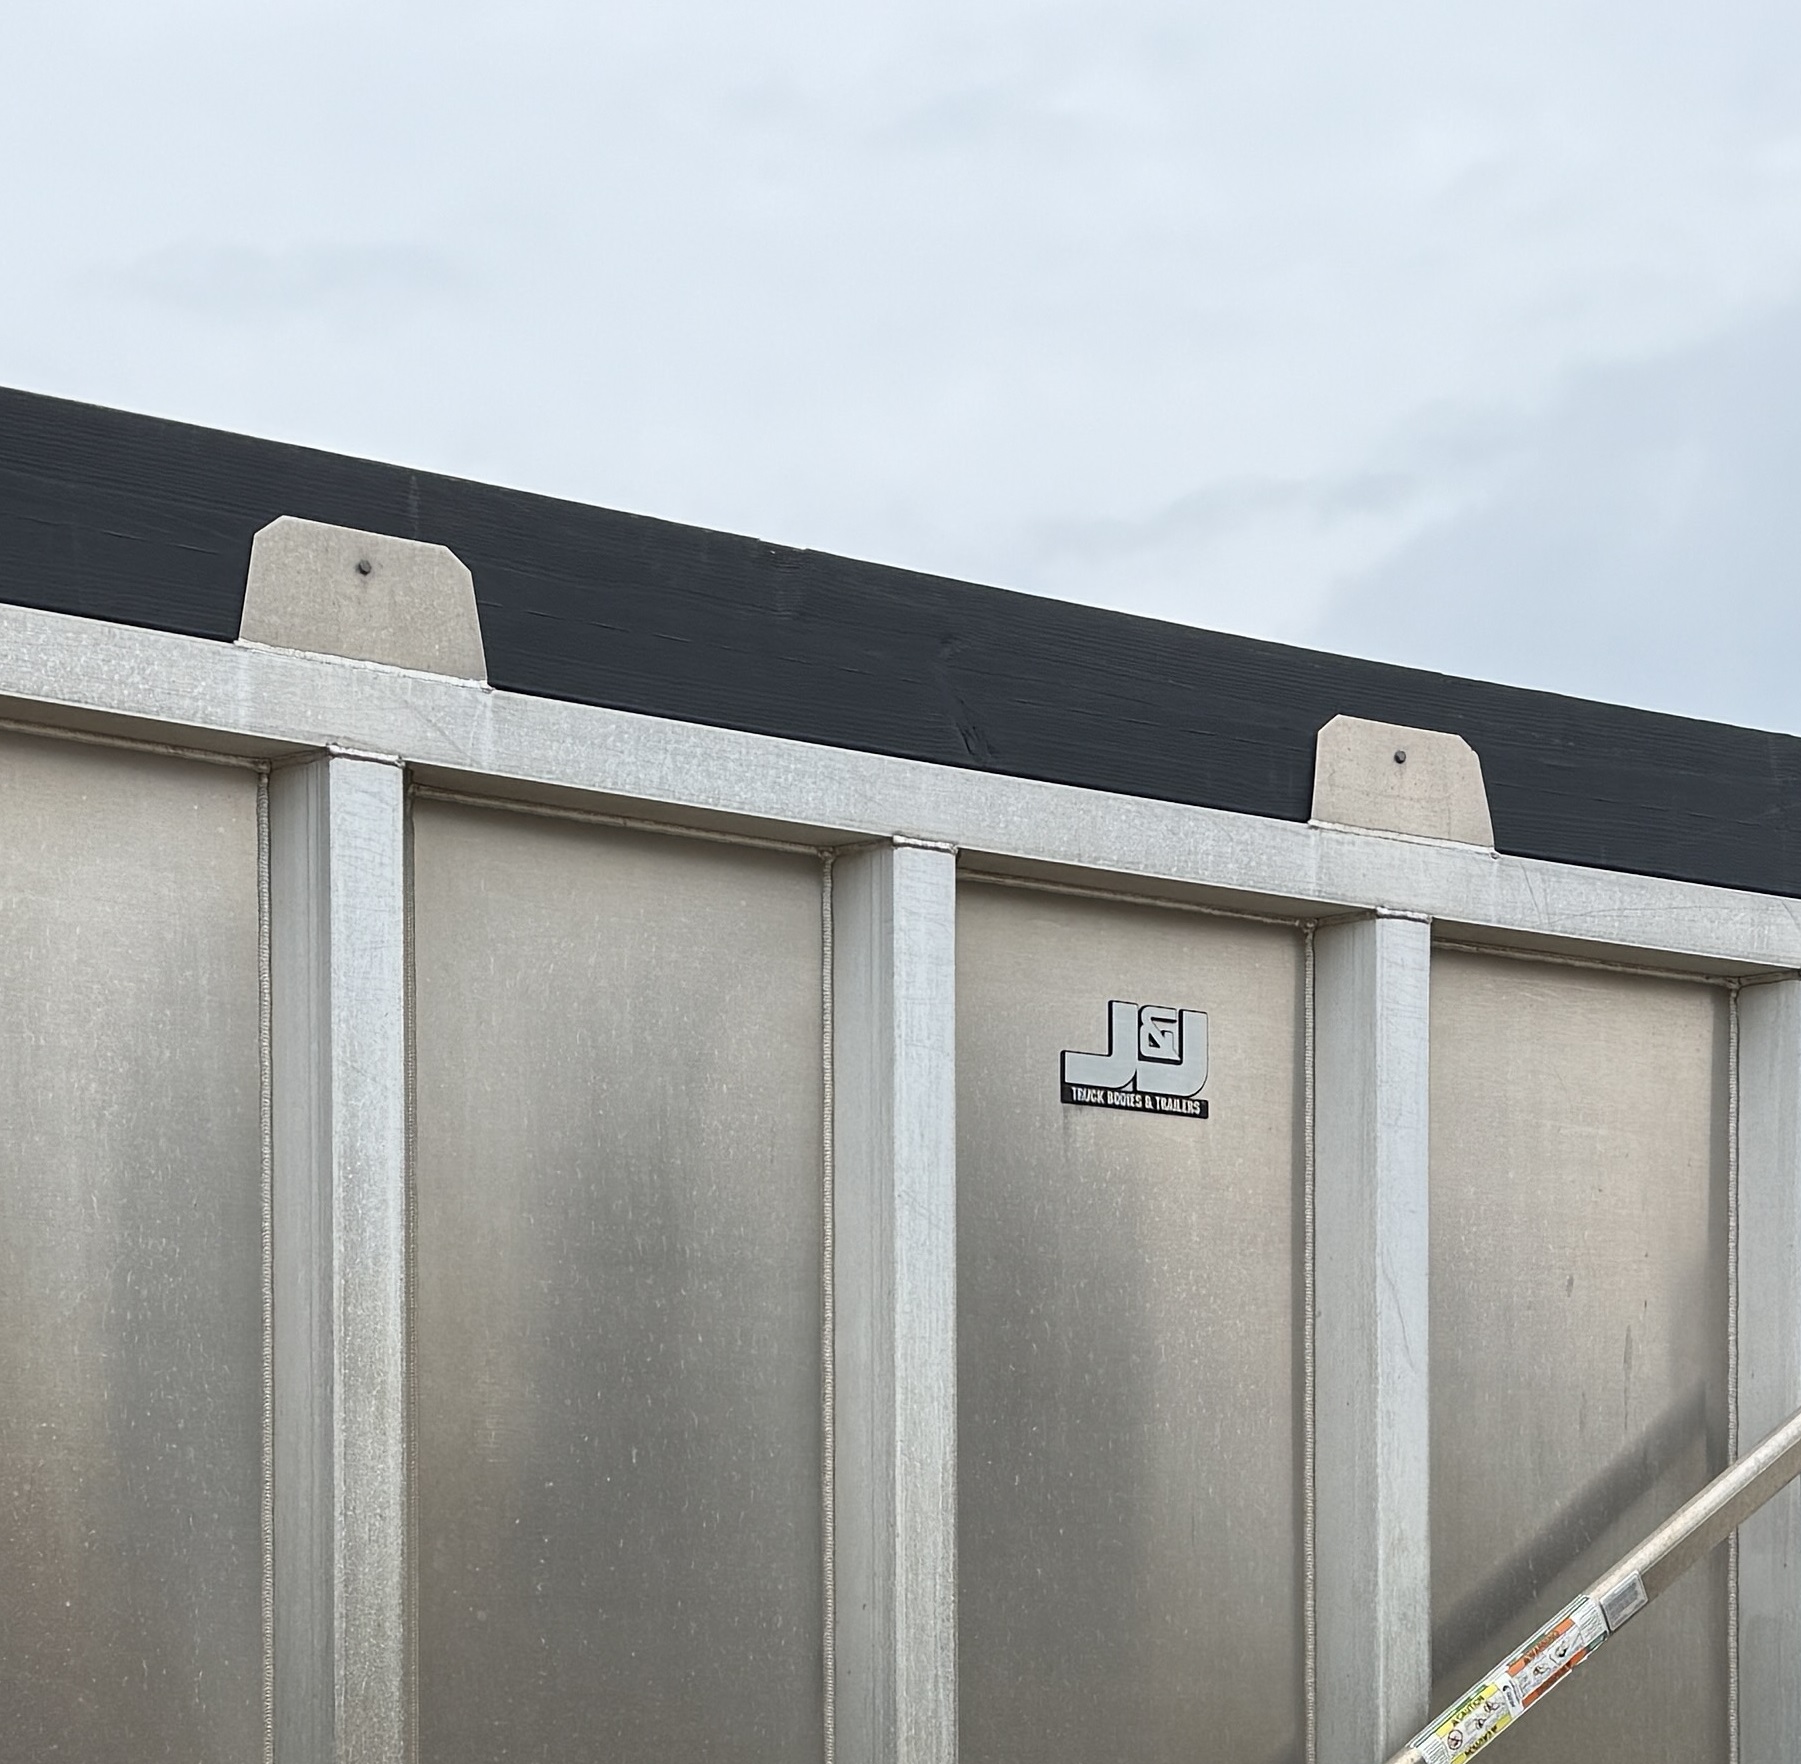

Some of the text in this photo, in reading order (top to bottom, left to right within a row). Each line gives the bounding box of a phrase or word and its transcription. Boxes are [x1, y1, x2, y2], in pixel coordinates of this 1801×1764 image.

[1071, 1087, 1200, 1115] TRUCK BODIES & TRAILERS
